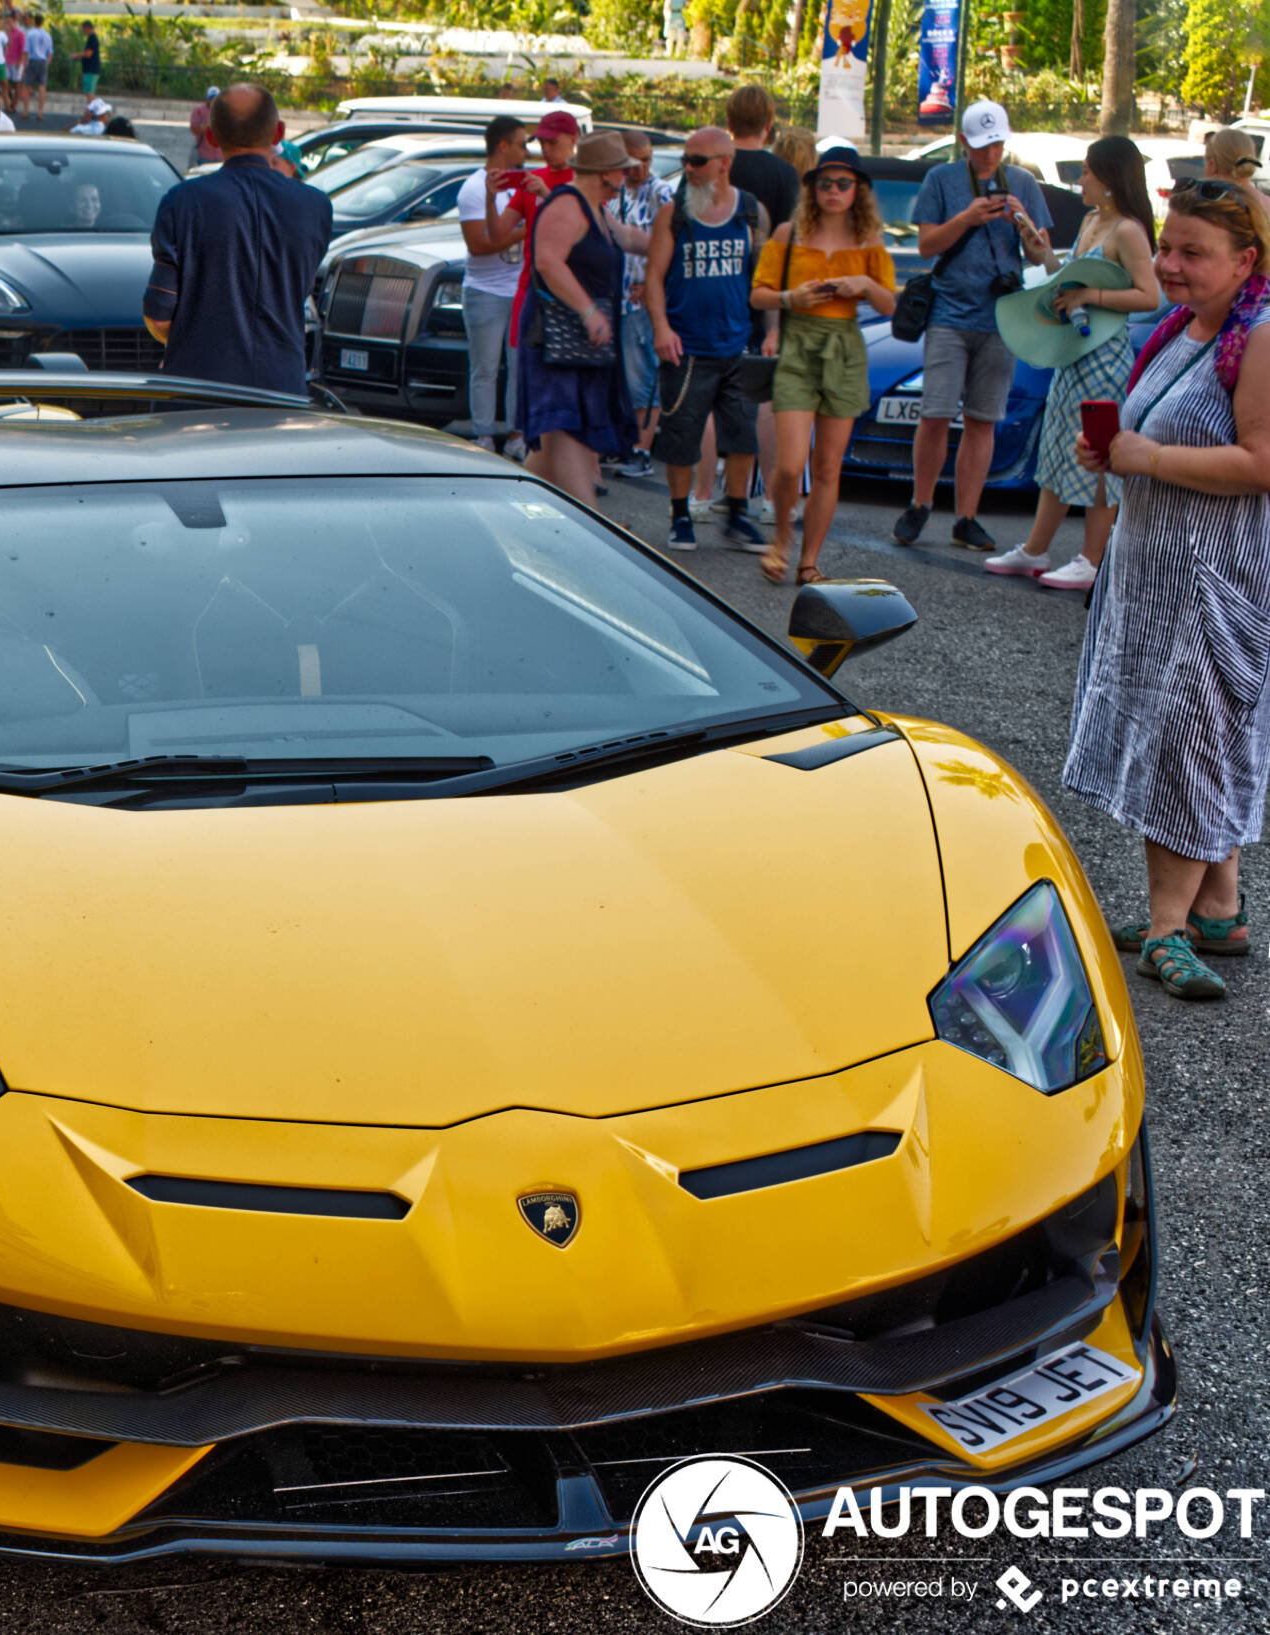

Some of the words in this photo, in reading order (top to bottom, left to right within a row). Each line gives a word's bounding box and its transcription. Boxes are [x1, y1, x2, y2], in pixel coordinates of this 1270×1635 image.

[683, 239, 744, 260] FRESH
[683, 258, 742, 278] BRAND
[521, 1194, 573, 1206] LAMBORGHINI
[928, 1387, 1047, 1446] SV19
[1033, 1346, 1124, 1402] JET
